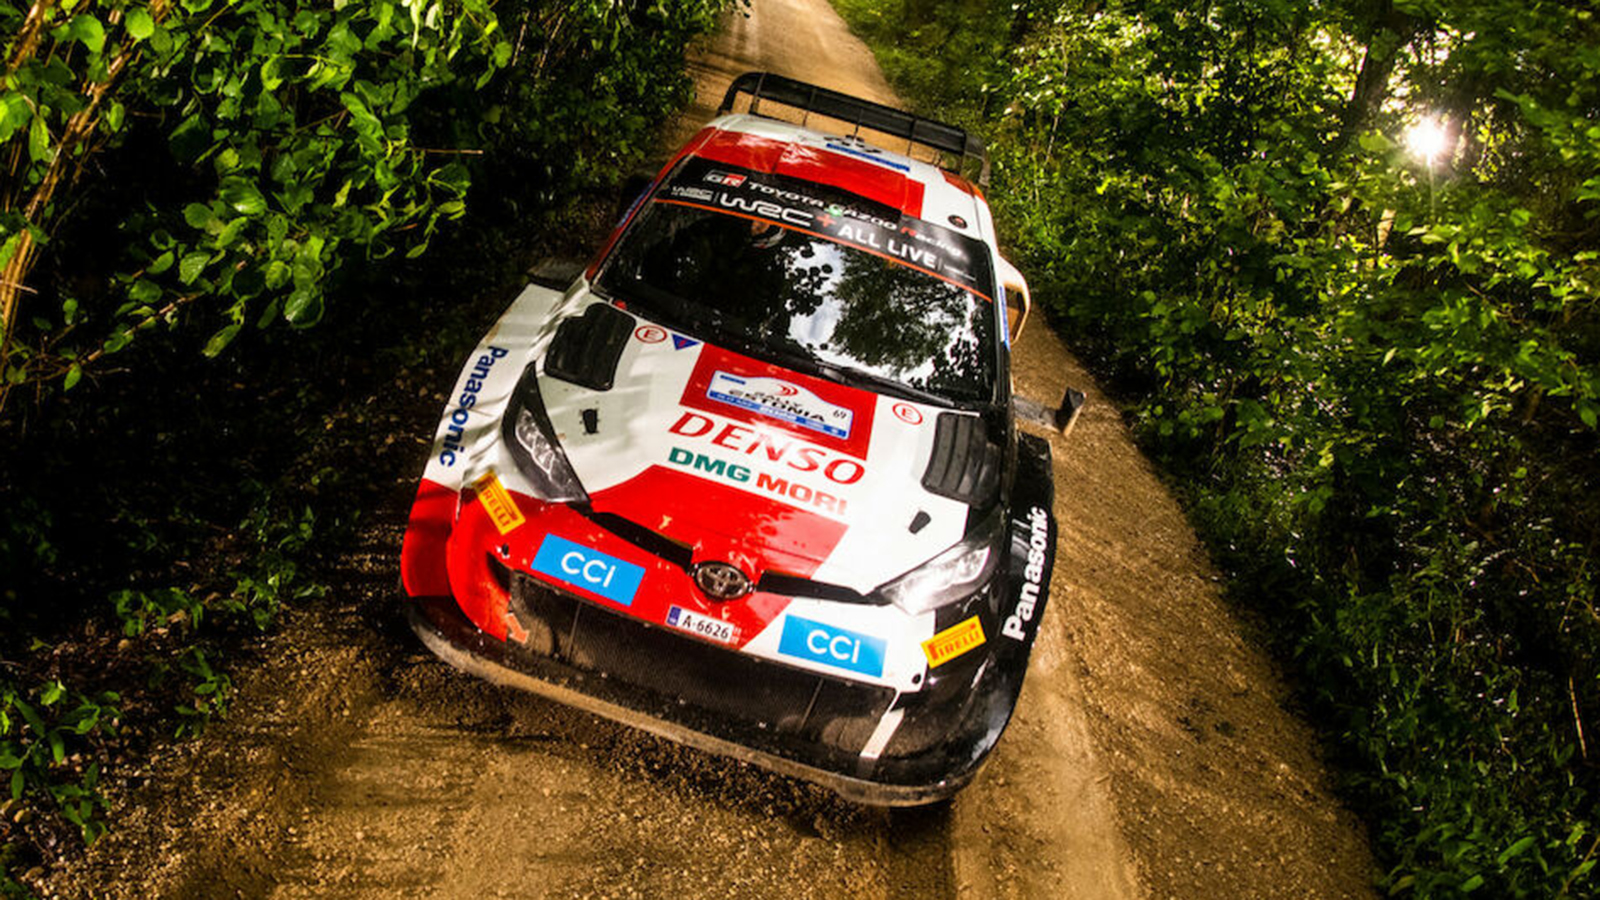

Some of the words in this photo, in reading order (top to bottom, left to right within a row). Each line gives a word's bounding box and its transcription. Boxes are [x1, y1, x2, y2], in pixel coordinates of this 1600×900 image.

[749, 181, 824, 208] TOYOTA
[825, 201, 898, 231] GAZOO
[837, 223, 881, 249] ALL
[887, 239, 937, 270] LIVE
[438, 344, 509, 467] Panasonic
[832, 409, 848, 419] 69
[668, 411, 866, 485] DENSO
[667, 446, 752, 483] DMG
[755, 472, 849, 516] MORI
[560, 551, 617, 589] CCI
[1001, 505, 1048, 642] Panasonic
[806, 619, 861, 664] CCI
[926, 621, 980, 661] PIRELLI
